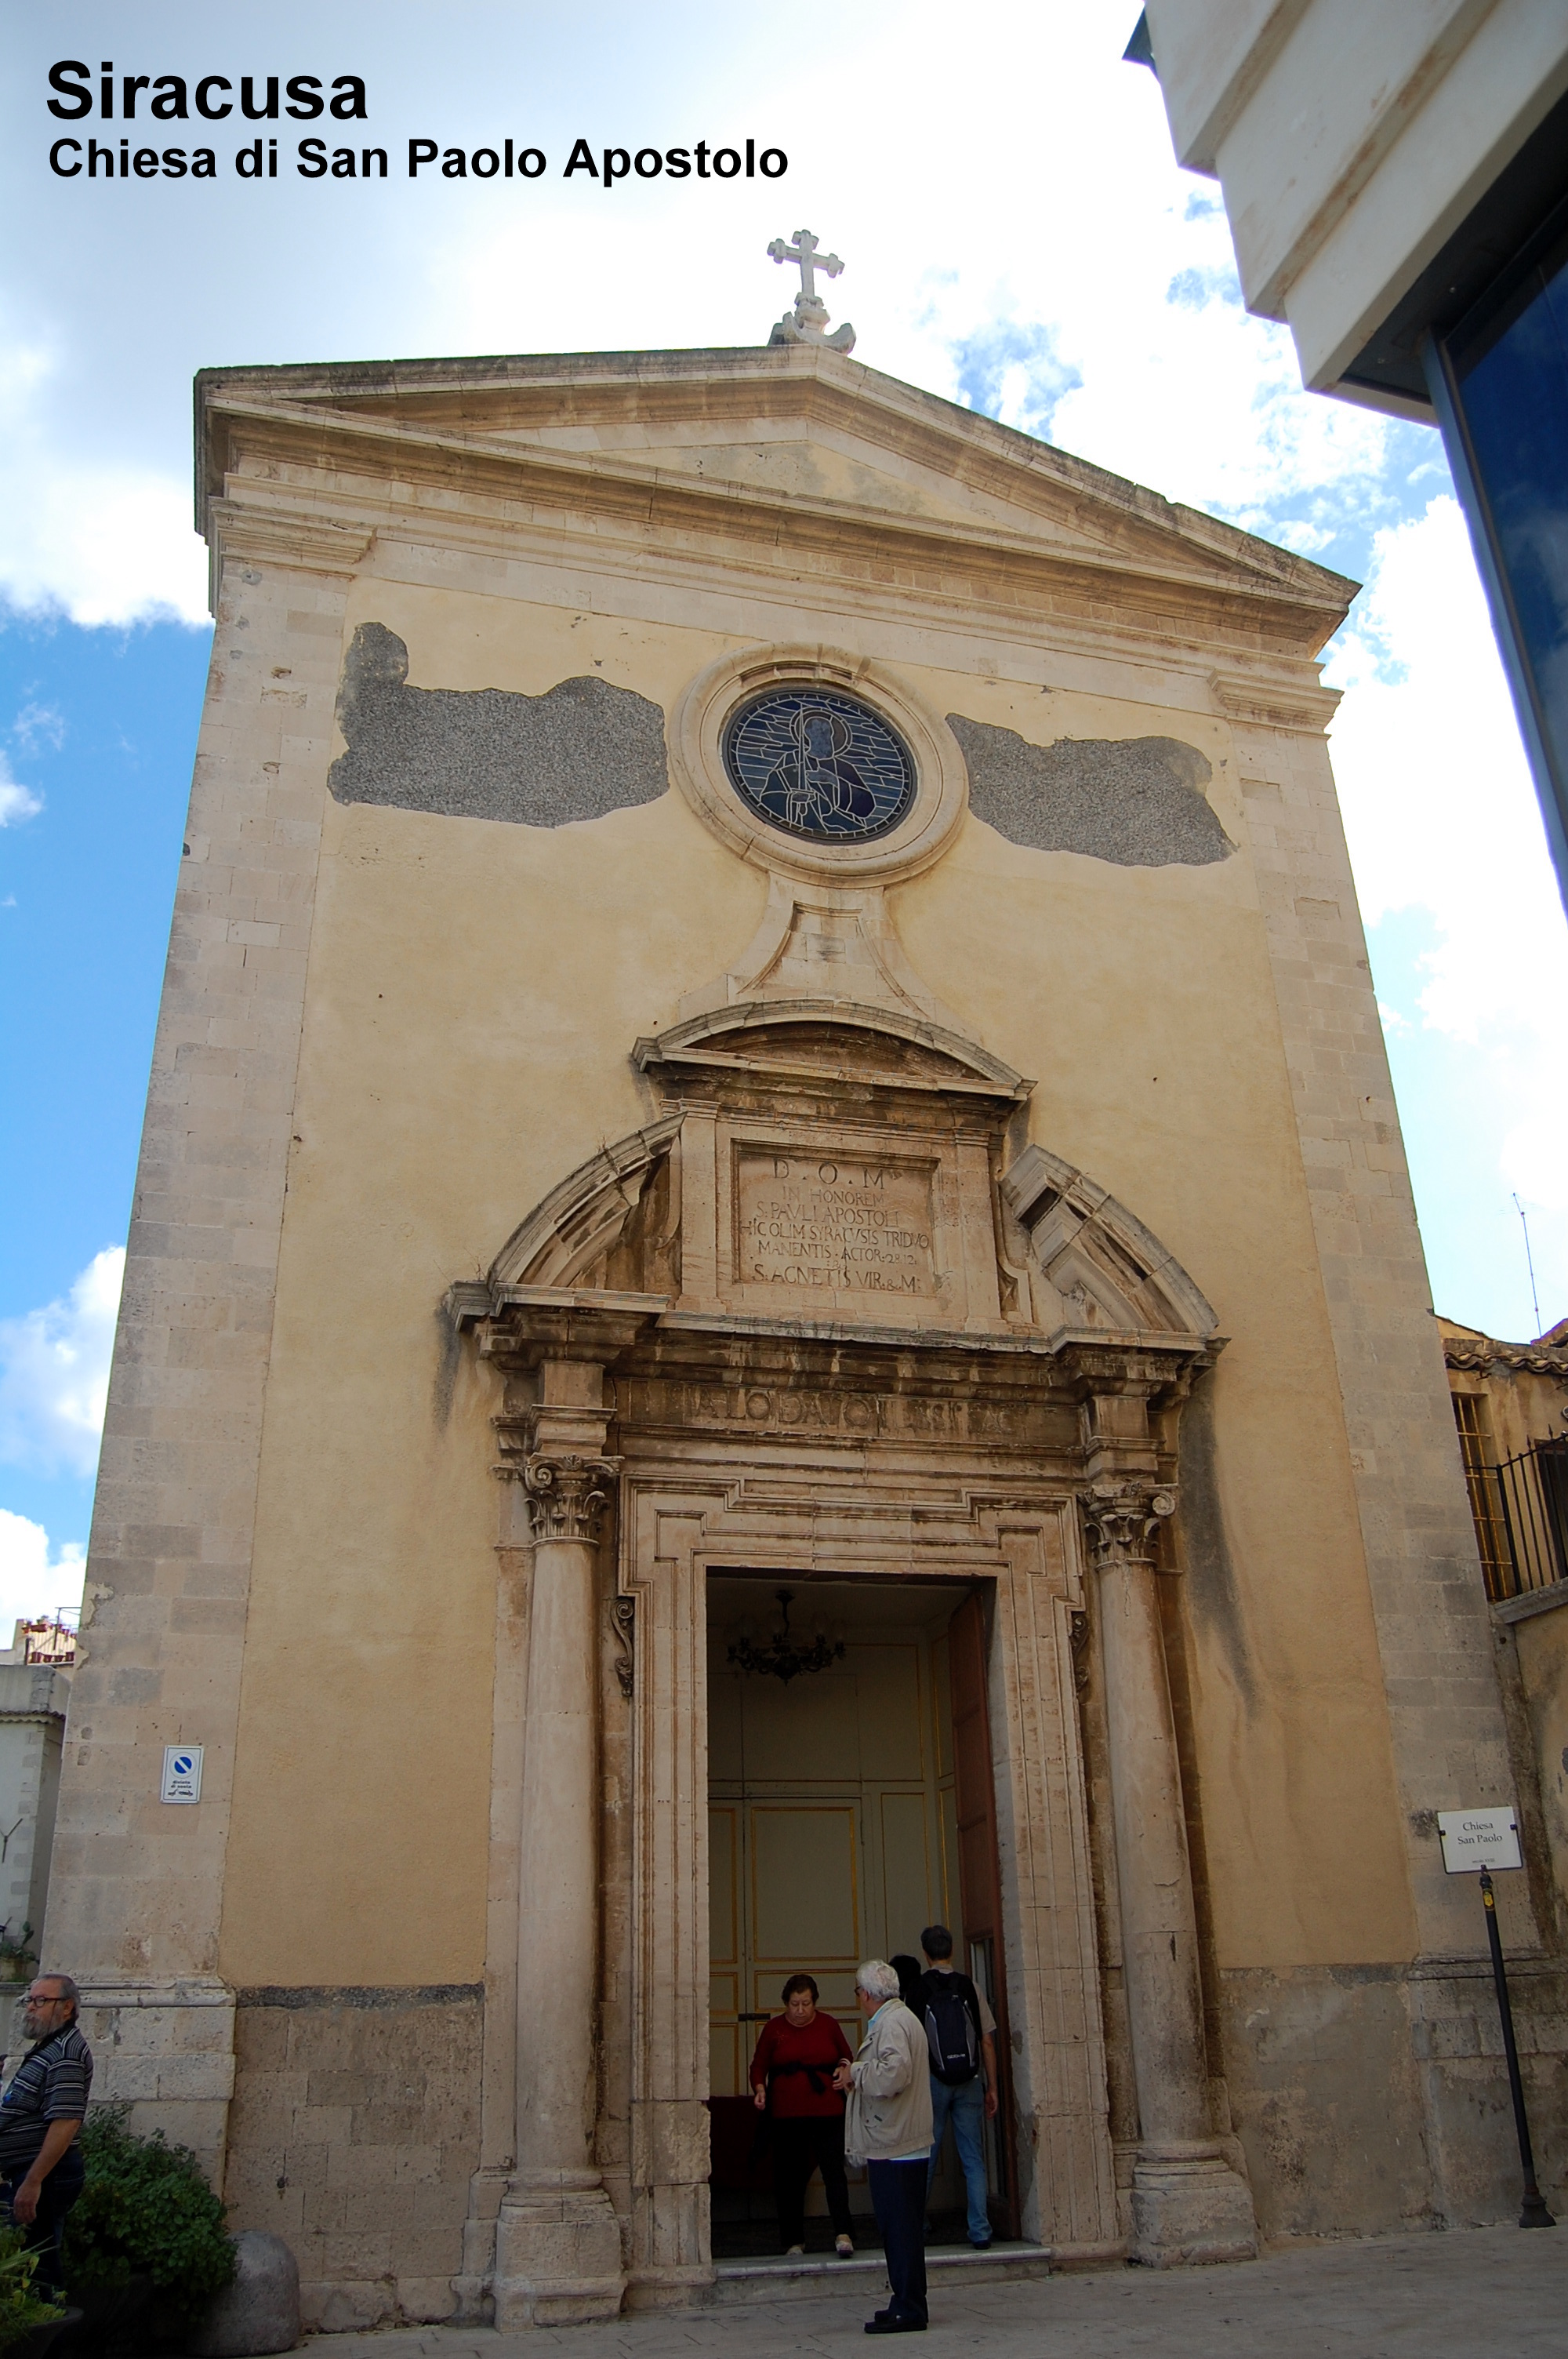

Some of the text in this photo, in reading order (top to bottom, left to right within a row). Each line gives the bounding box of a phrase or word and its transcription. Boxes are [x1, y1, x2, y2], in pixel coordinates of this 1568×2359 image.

[782, 1185, 884, 1206] IN HONOREM
[769, 1223, 805, 1239] OLIM
[1462, 1821, 1494, 1831] Chiesa
[1457, 1834, 1503, 1845] San Paolo
